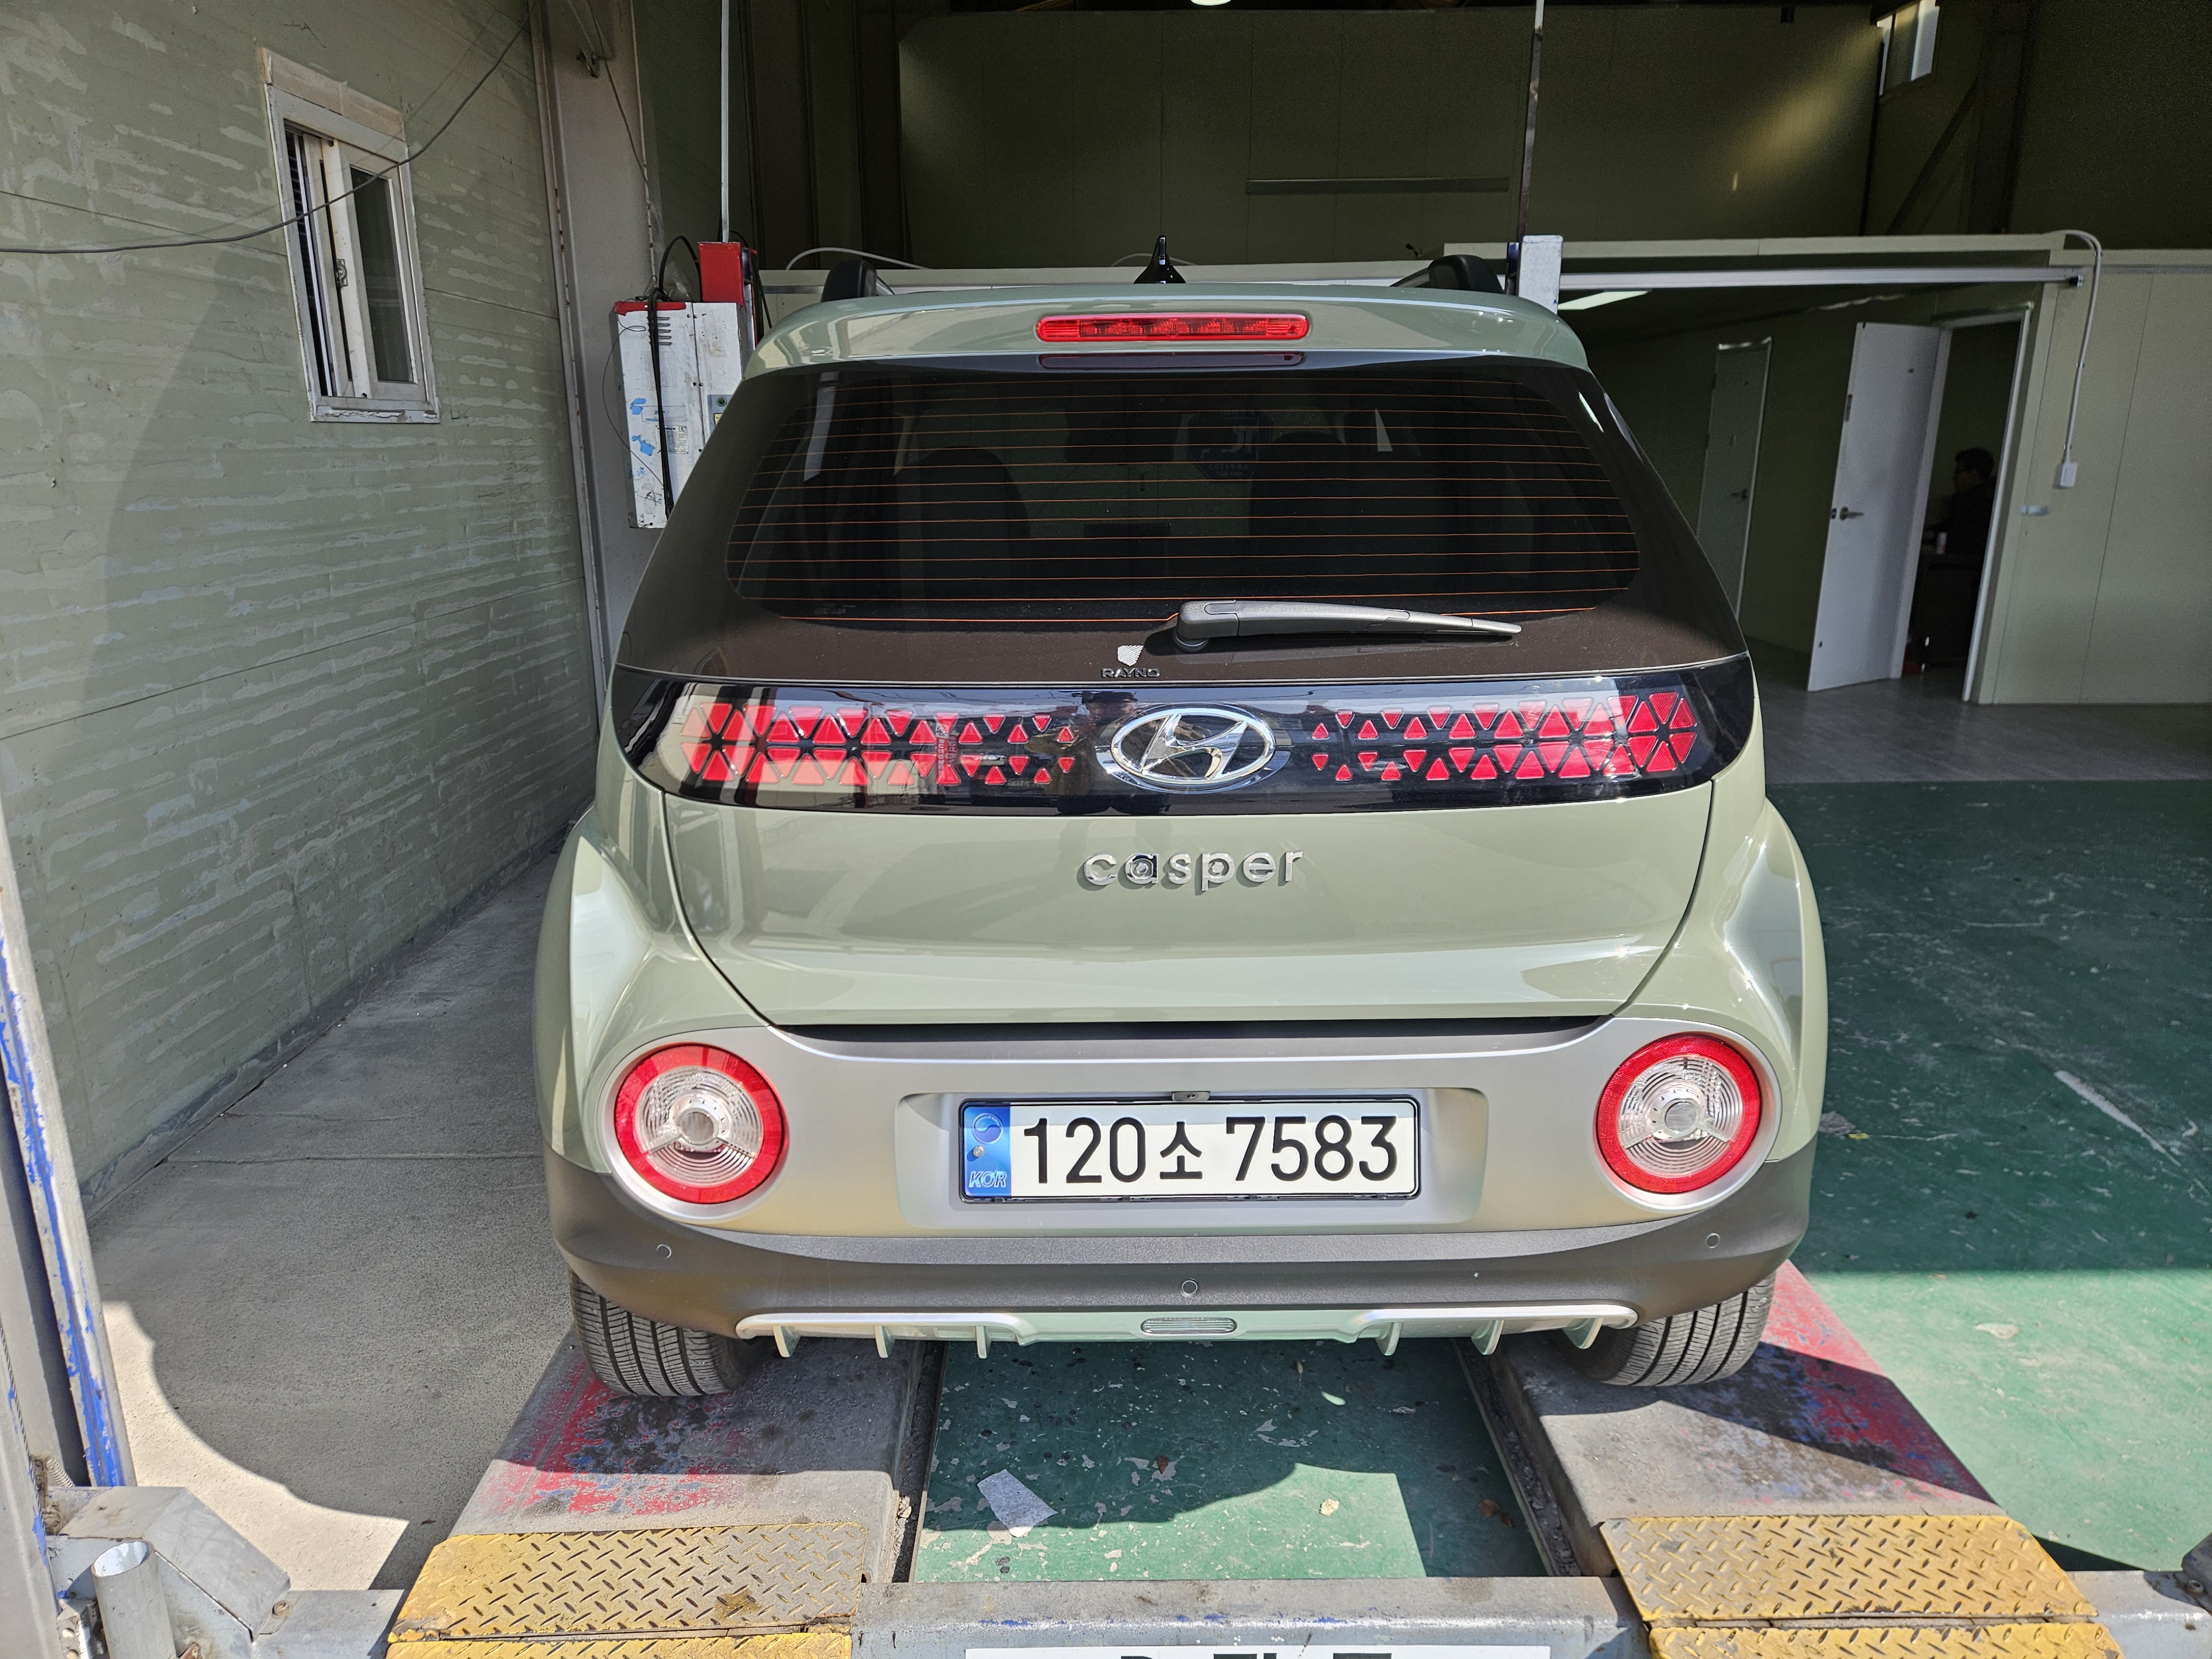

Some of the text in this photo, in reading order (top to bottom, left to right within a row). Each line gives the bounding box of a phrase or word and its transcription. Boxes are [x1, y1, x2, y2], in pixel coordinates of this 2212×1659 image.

[1102, 667, 1160, 677] RAYNO
[1084, 851, 1303, 891] casper
[1024, 1115, 1397, 1184] 120소 7583
[968, 1171, 1007, 1187] KOR
